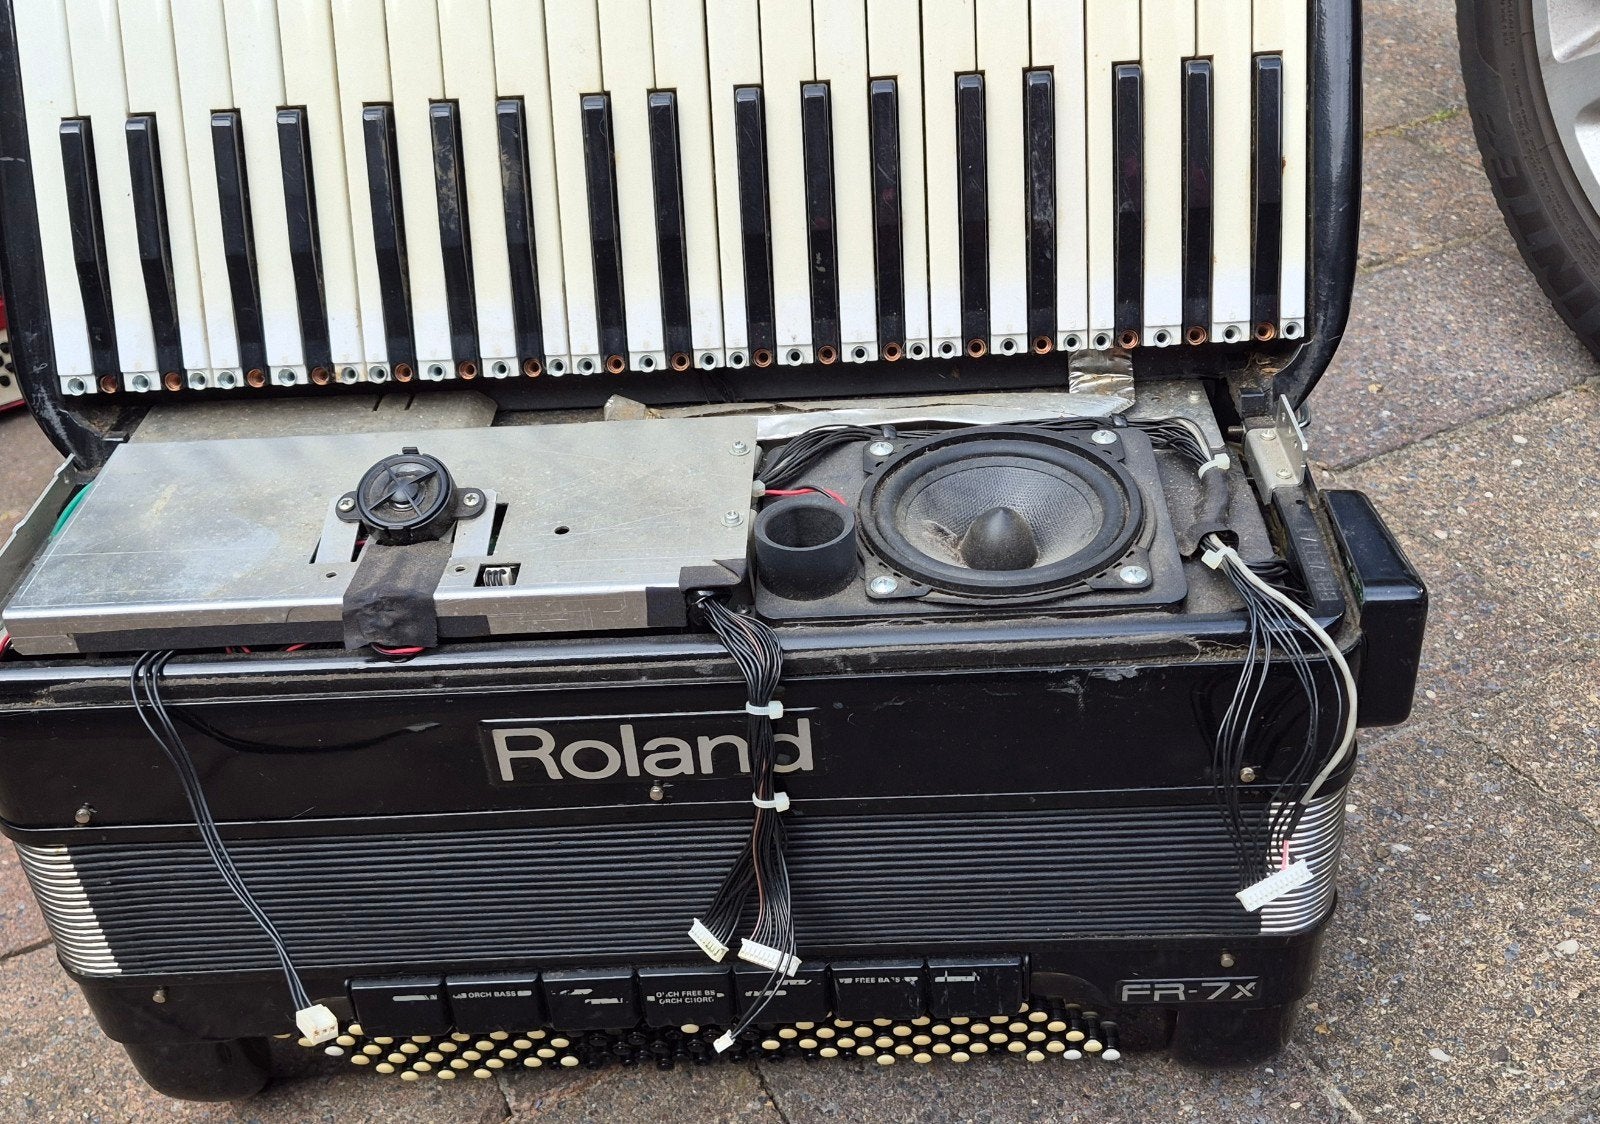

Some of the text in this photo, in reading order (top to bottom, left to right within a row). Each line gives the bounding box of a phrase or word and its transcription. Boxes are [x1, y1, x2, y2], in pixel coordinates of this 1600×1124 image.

[492, 718, 814, 781] Roland
[854, 976, 876, 984] FREE
[468, 990, 517, 999] ORCH BASS
[681, 989, 703, 997] FREE
